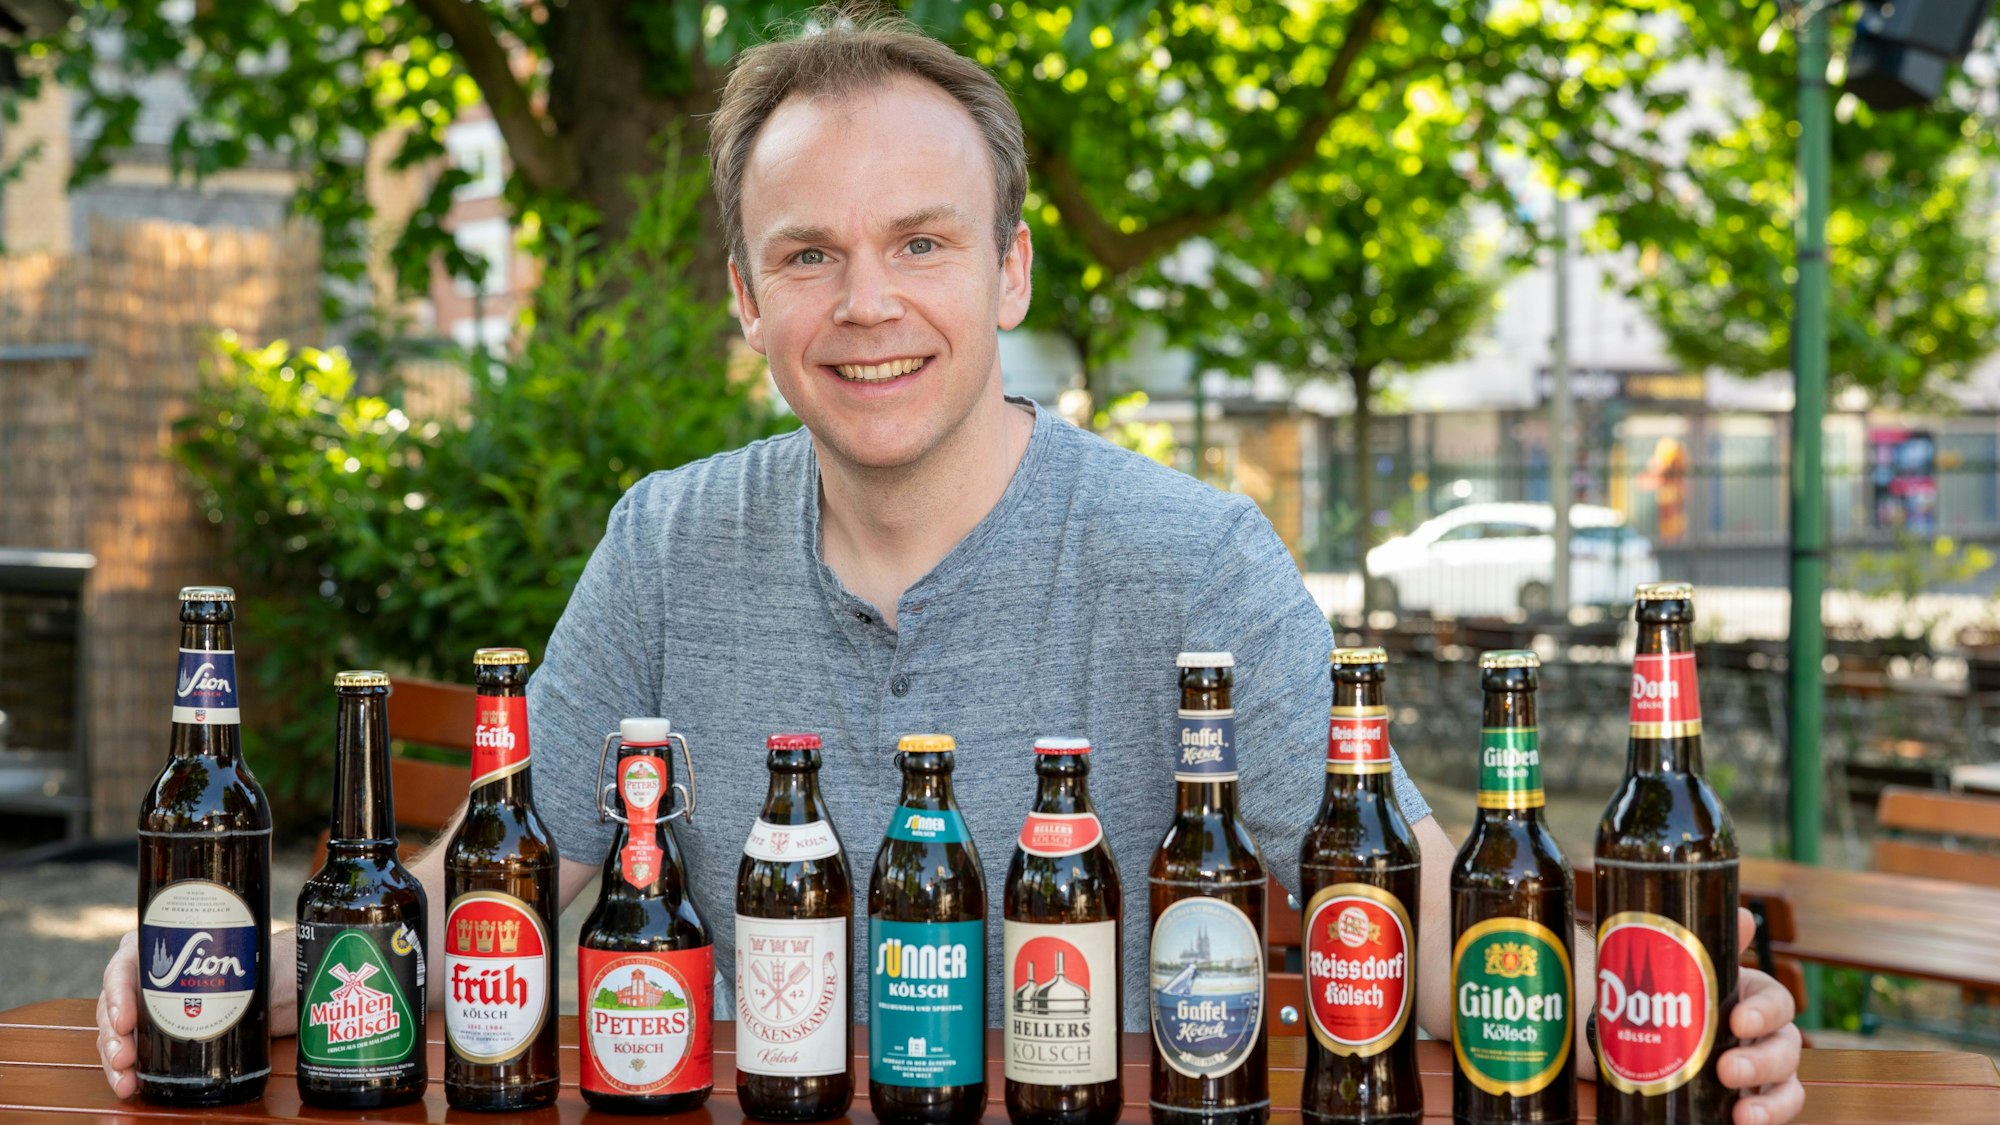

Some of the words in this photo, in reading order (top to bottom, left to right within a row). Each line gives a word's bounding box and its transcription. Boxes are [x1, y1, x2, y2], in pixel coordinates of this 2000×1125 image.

[177, 662, 232, 698] Sion
[1632, 673, 1679, 699] Dom
[475, 724, 515, 751] früh
[1181, 727, 1224, 747] Gaffel
[1483, 746, 1539, 767] Gilden
[626, 781, 658, 790] PETERS
[904, 815, 945, 832] SÜNNER
[148, 931, 247, 988] Sion
[876, 938, 967, 979] SÜNNER
[1310, 950, 1403, 981] Reissdorf
[180, 977, 226, 988] KÖLSCH
[451, 963, 527, 1009] früh
[754, 988, 767, 998] 14
[789, 990, 804, 998] 42
[889, 982, 948, 998] KÖLSCH
[1325, 981, 1384, 1009] Kölsch
[1459, 981, 1563, 1022] Gilden
[1599, 968, 1692, 1029] Dom
[310, 995, 392, 1026] Mühlen
[462, 1008, 508, 1020] KÖLSCH
[737, 975, 837, 1042] SCHRECKENSKAMMER
[1177, 1000, 1227, 1022] Gaffel
[328, 1012, 399, 1043] Kölsch
[594, 1011, 685, 1036] PETERS
[1013, 1019, 1091, 1038] HELLERS
[1175, 1021, 1228, 1043] Kölsch
[1482, 1022, 1538, 1043] Kölsch
[613, 1041, 664, 1054] KÖLSCH
[1617, 1029, 1661, 1044] KÖLSCH
[757, 1048, 800, 1066] Kölsch
[1012, 1042, 1091, 1062] KÖLSCH
